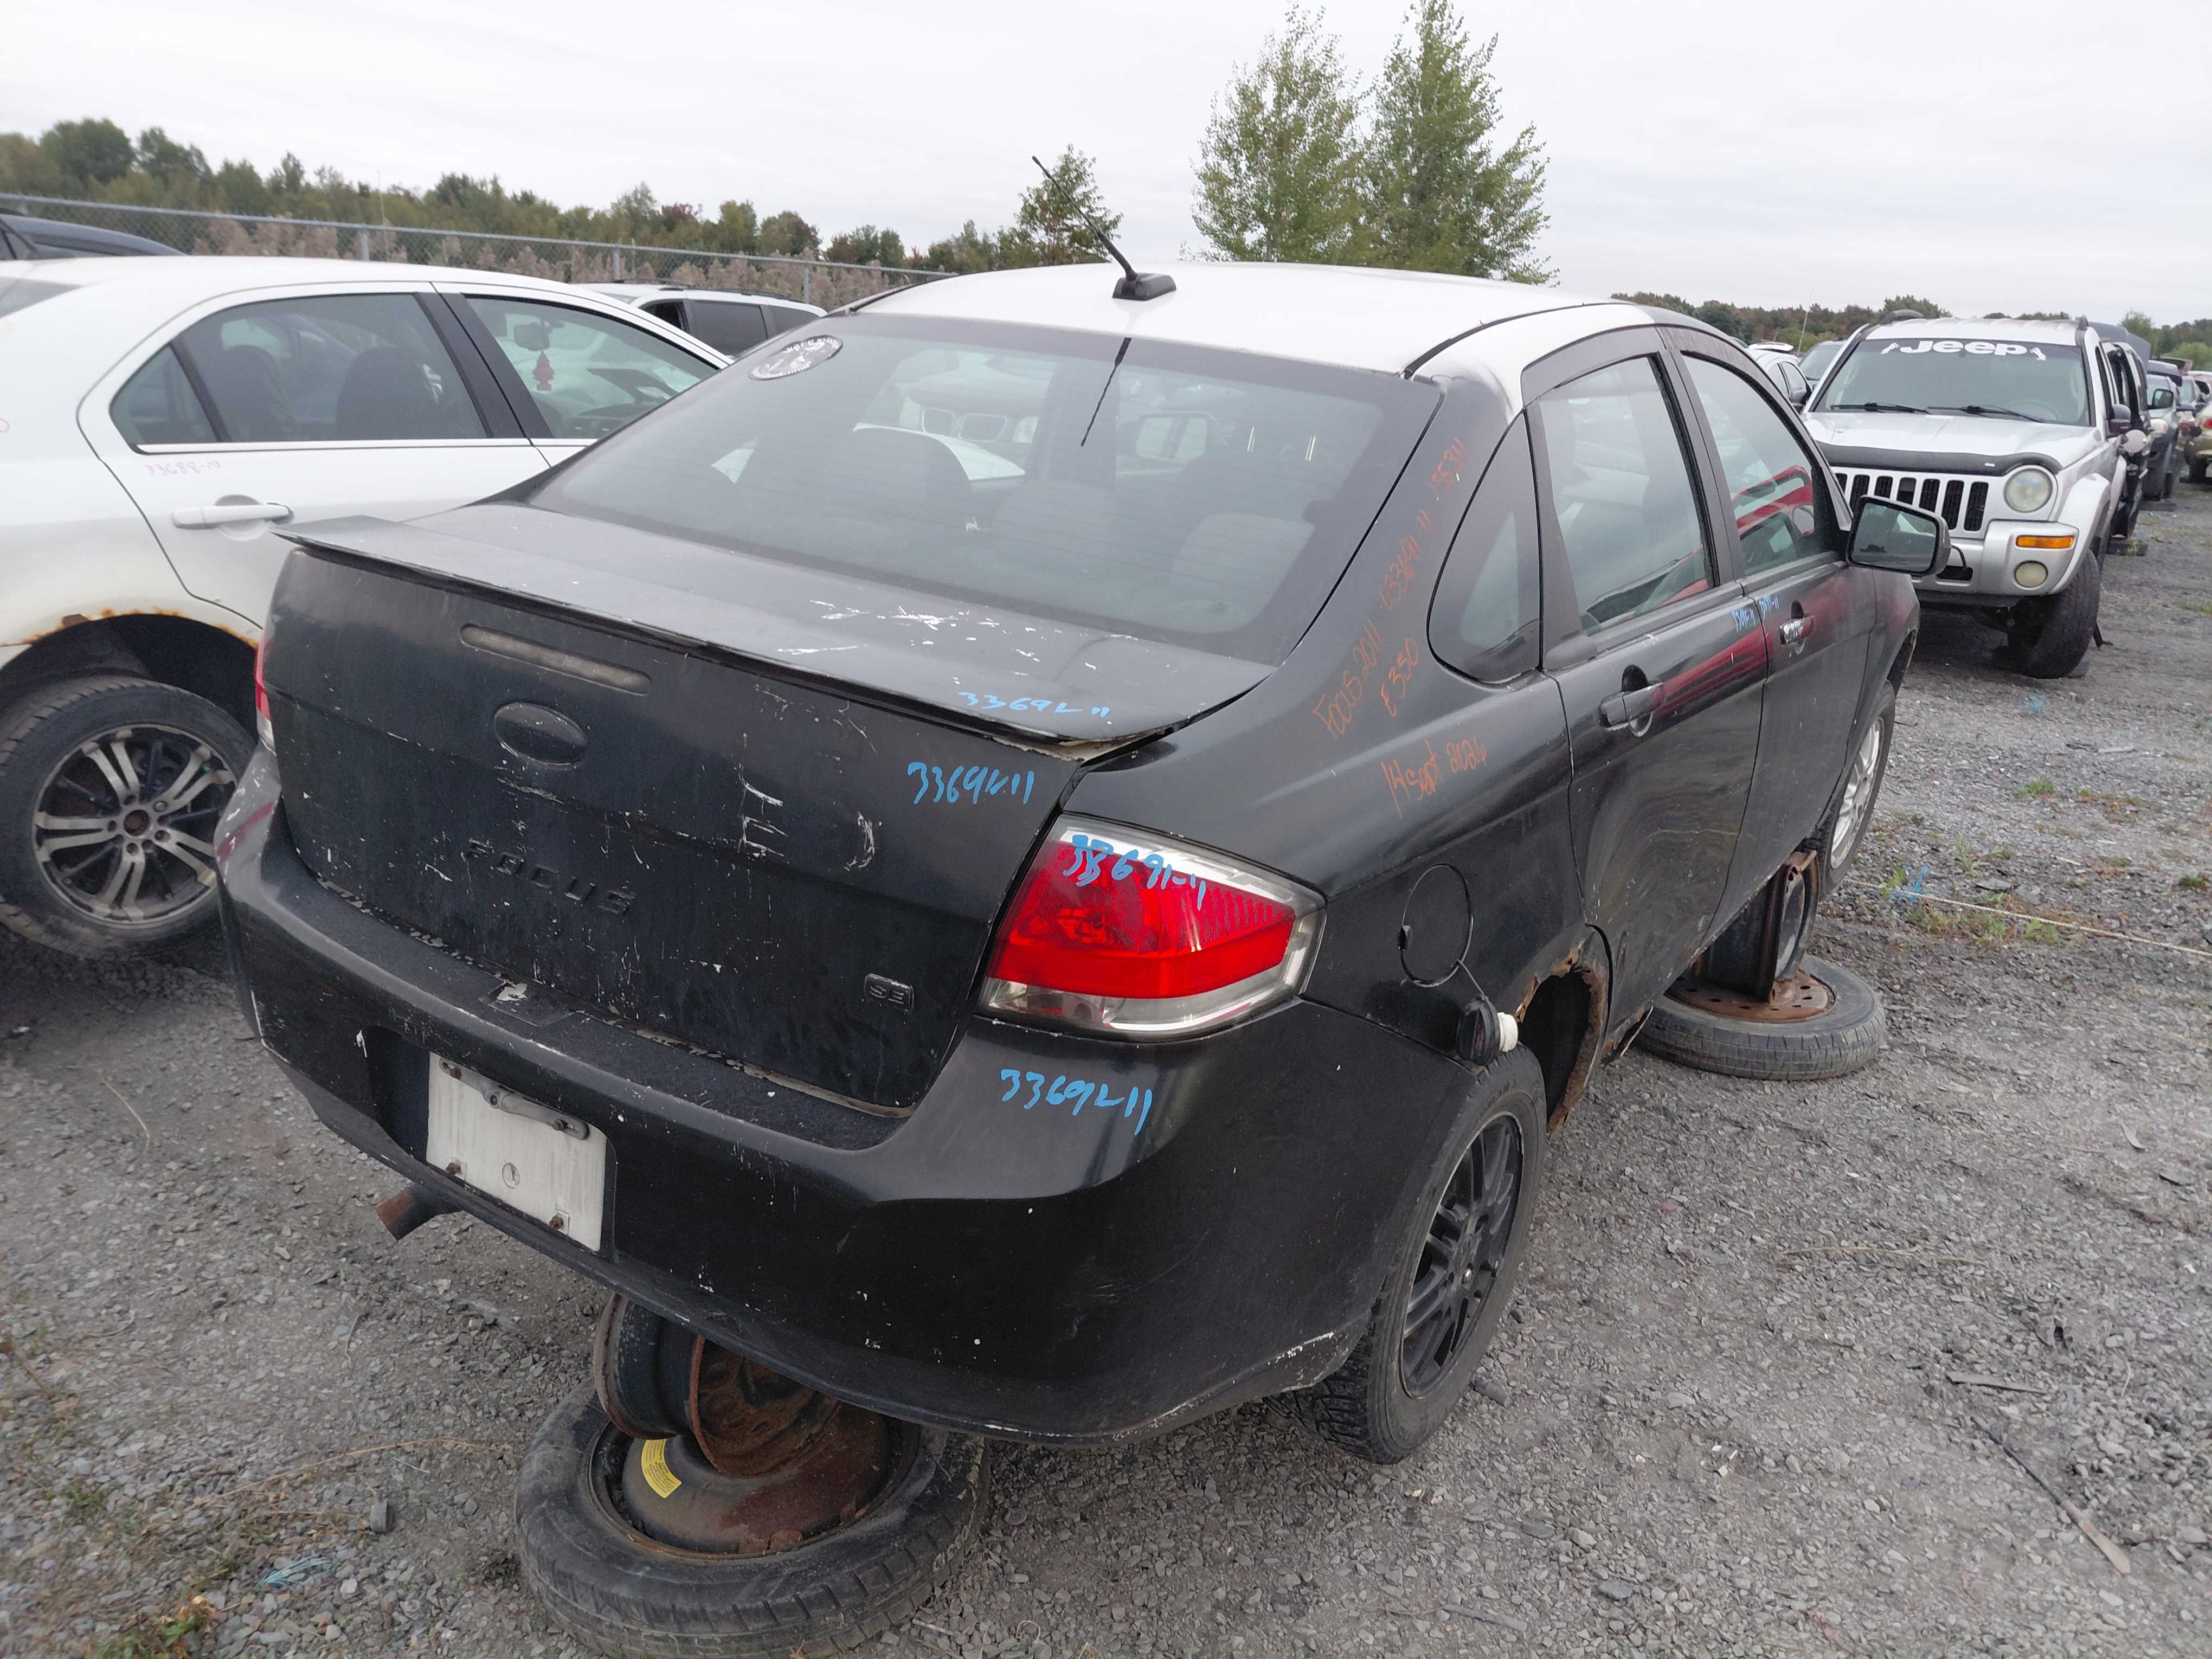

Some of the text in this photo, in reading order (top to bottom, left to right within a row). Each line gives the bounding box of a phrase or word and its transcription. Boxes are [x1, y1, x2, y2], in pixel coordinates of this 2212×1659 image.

[1899, 340, 2028, 356] Jeep
[467, 838, 636, 915] FOCUS
[869, 985, 905, 1005] SE
